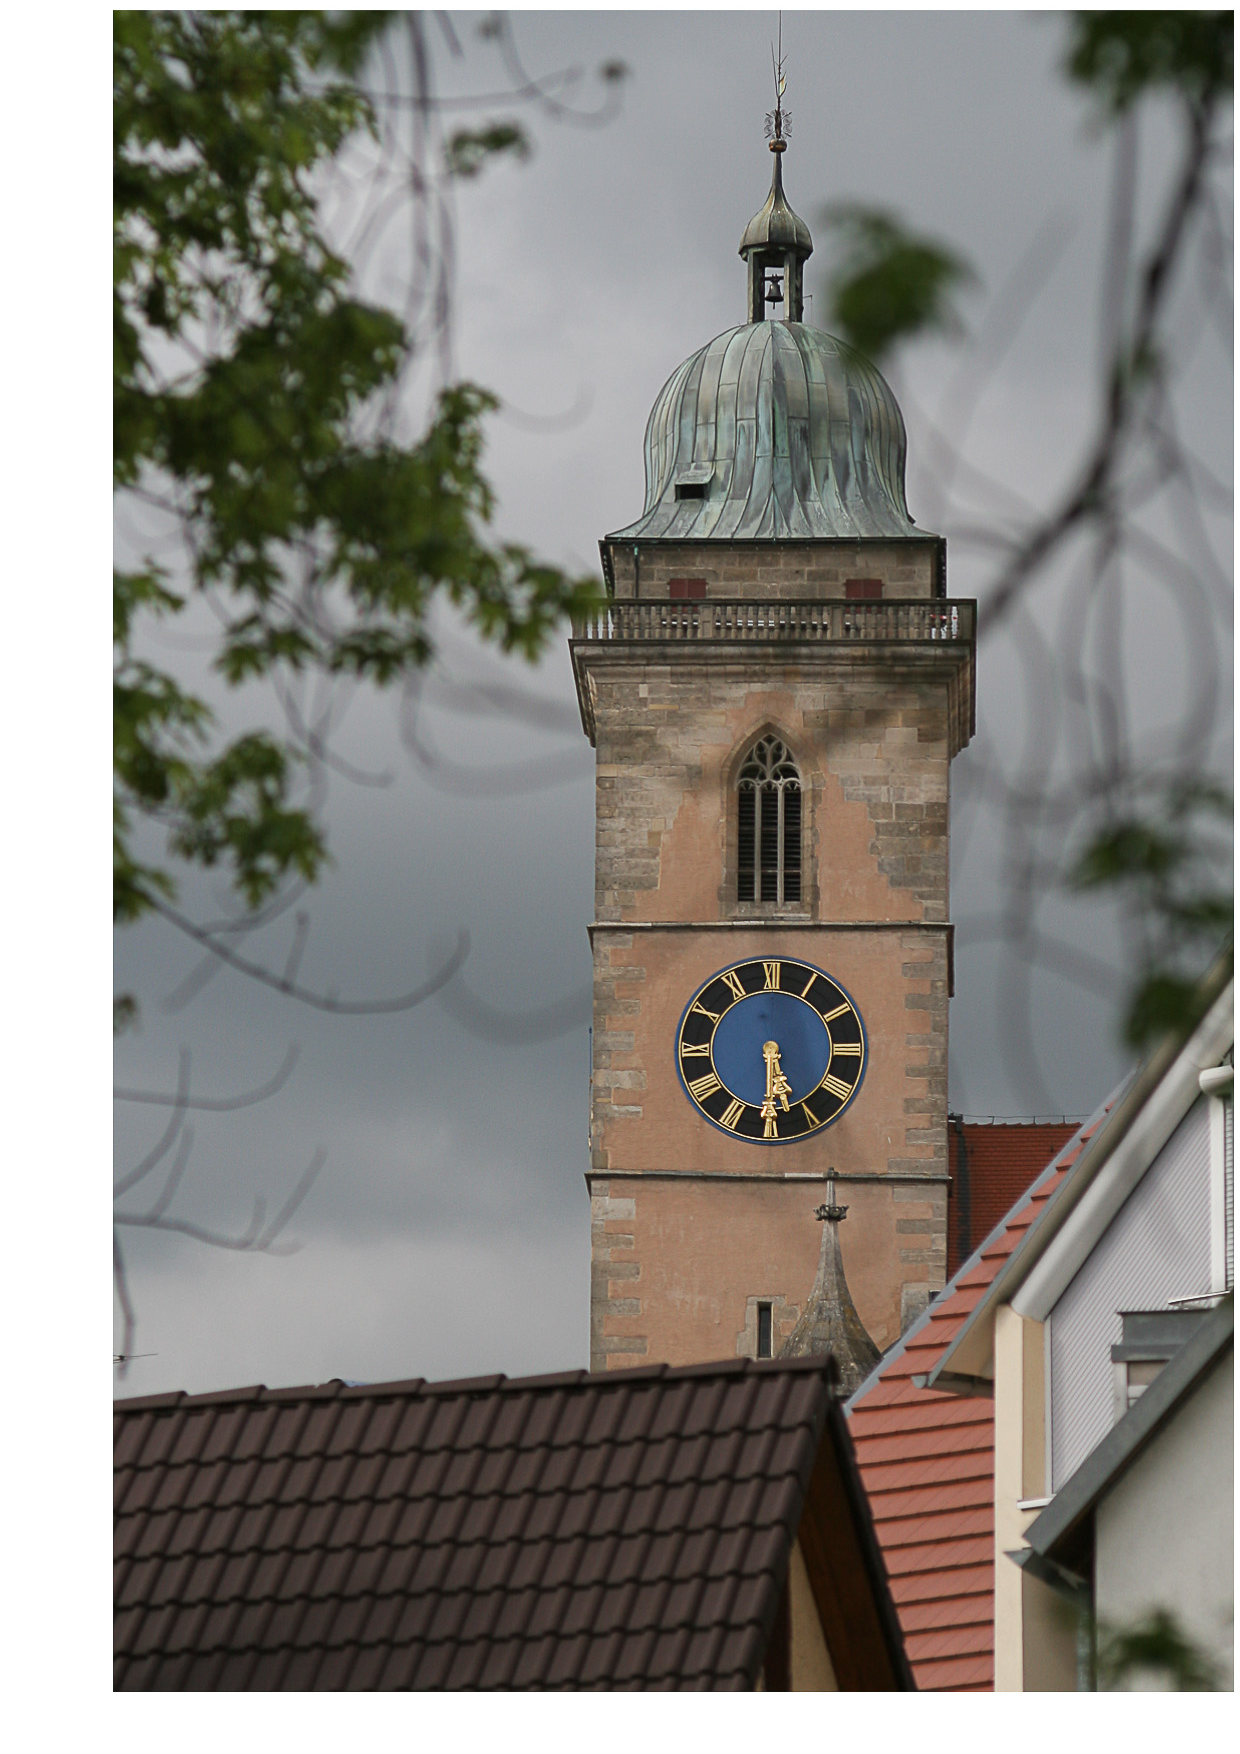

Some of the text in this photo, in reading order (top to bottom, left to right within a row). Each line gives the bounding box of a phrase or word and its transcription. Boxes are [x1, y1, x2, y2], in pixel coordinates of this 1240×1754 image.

[721, 971, 746, 1000] XI
[763, 962, 781, 989] XII
[692, 1001, 720, 1024] X
[823, 1002, 851, 1023] II
[682, 1041, 710, 1058] IX
[832, 1042, 861, 1056] III
[688, 1072, 722, 1102] VIII
[822, 1074, 853, 1101] IIII
[719, 1099, 746, 1130] VII
[801, 1102, 820, 1129] V
